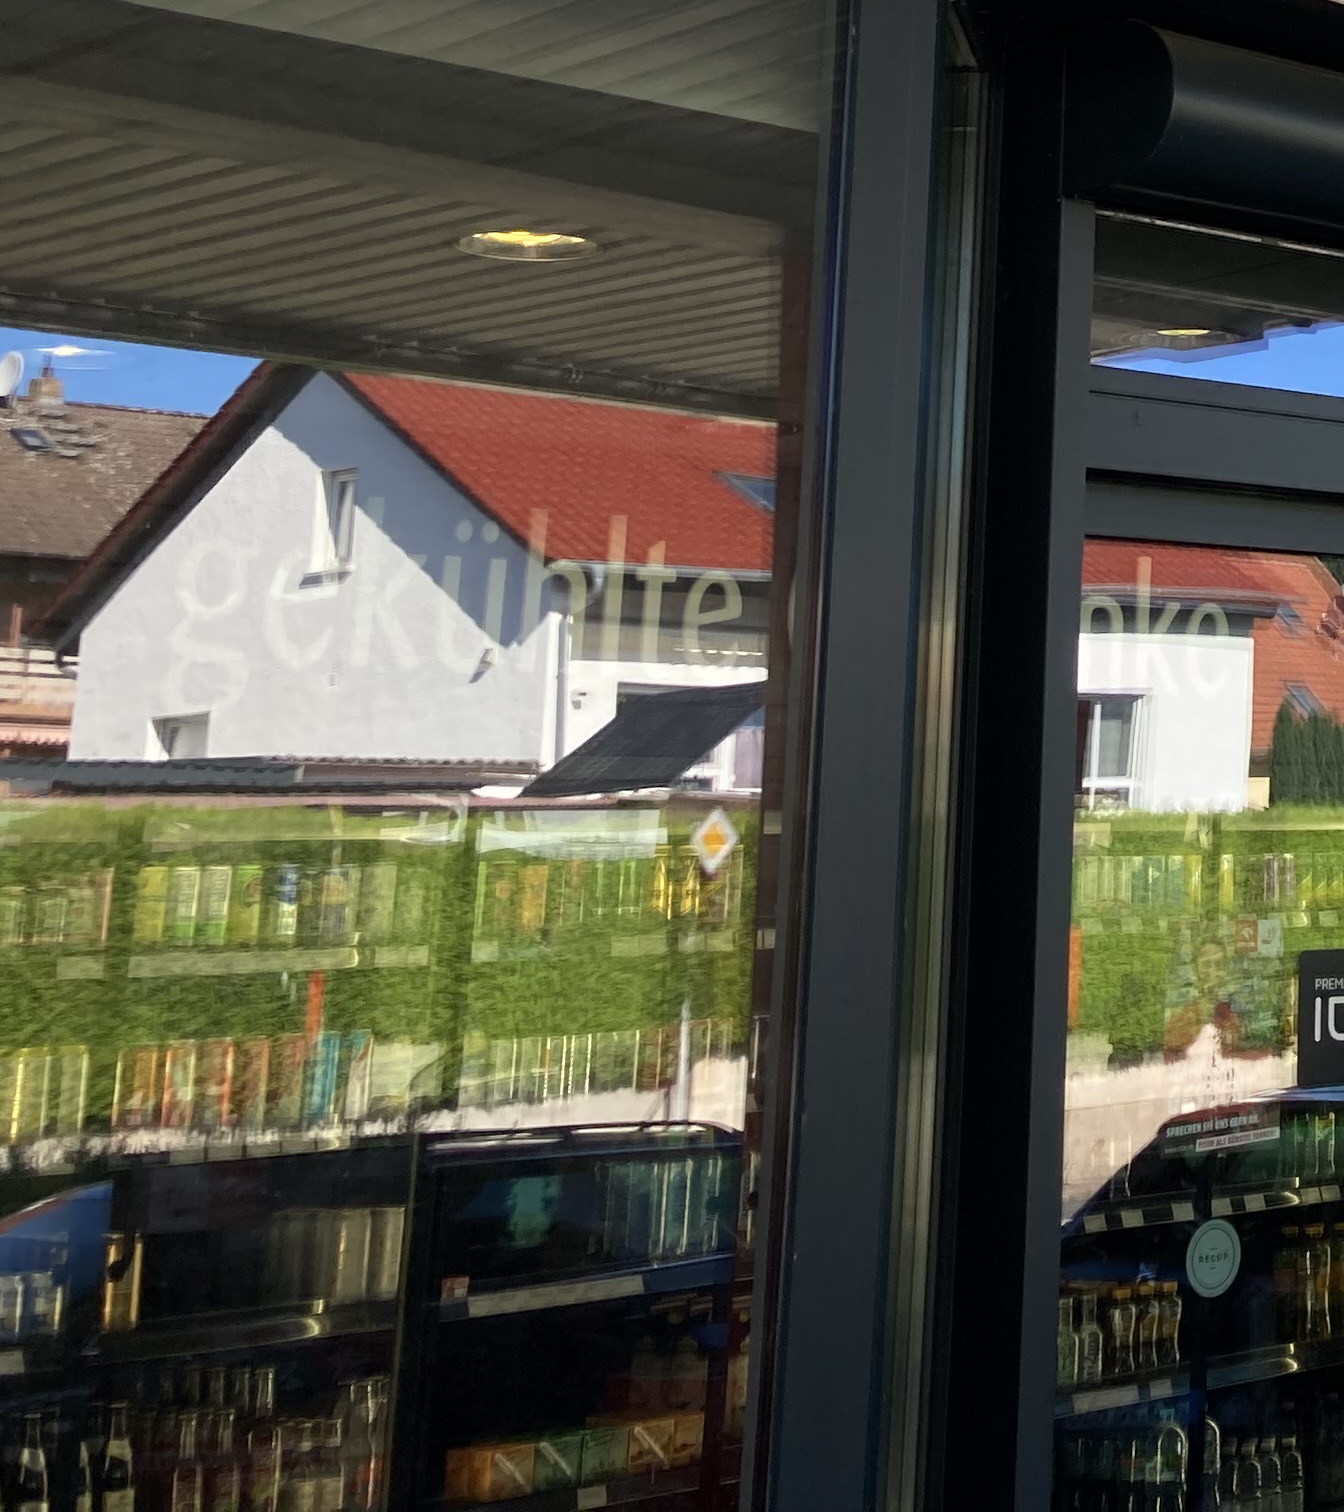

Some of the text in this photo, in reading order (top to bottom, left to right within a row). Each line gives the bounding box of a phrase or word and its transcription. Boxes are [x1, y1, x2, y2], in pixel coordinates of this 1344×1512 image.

[162, 495, 1230, 709] gekühlte nke
[1165, 1122, 1202, 1138] SPRECHEN
[1198, 1252, 1229, 1264] RECUP
